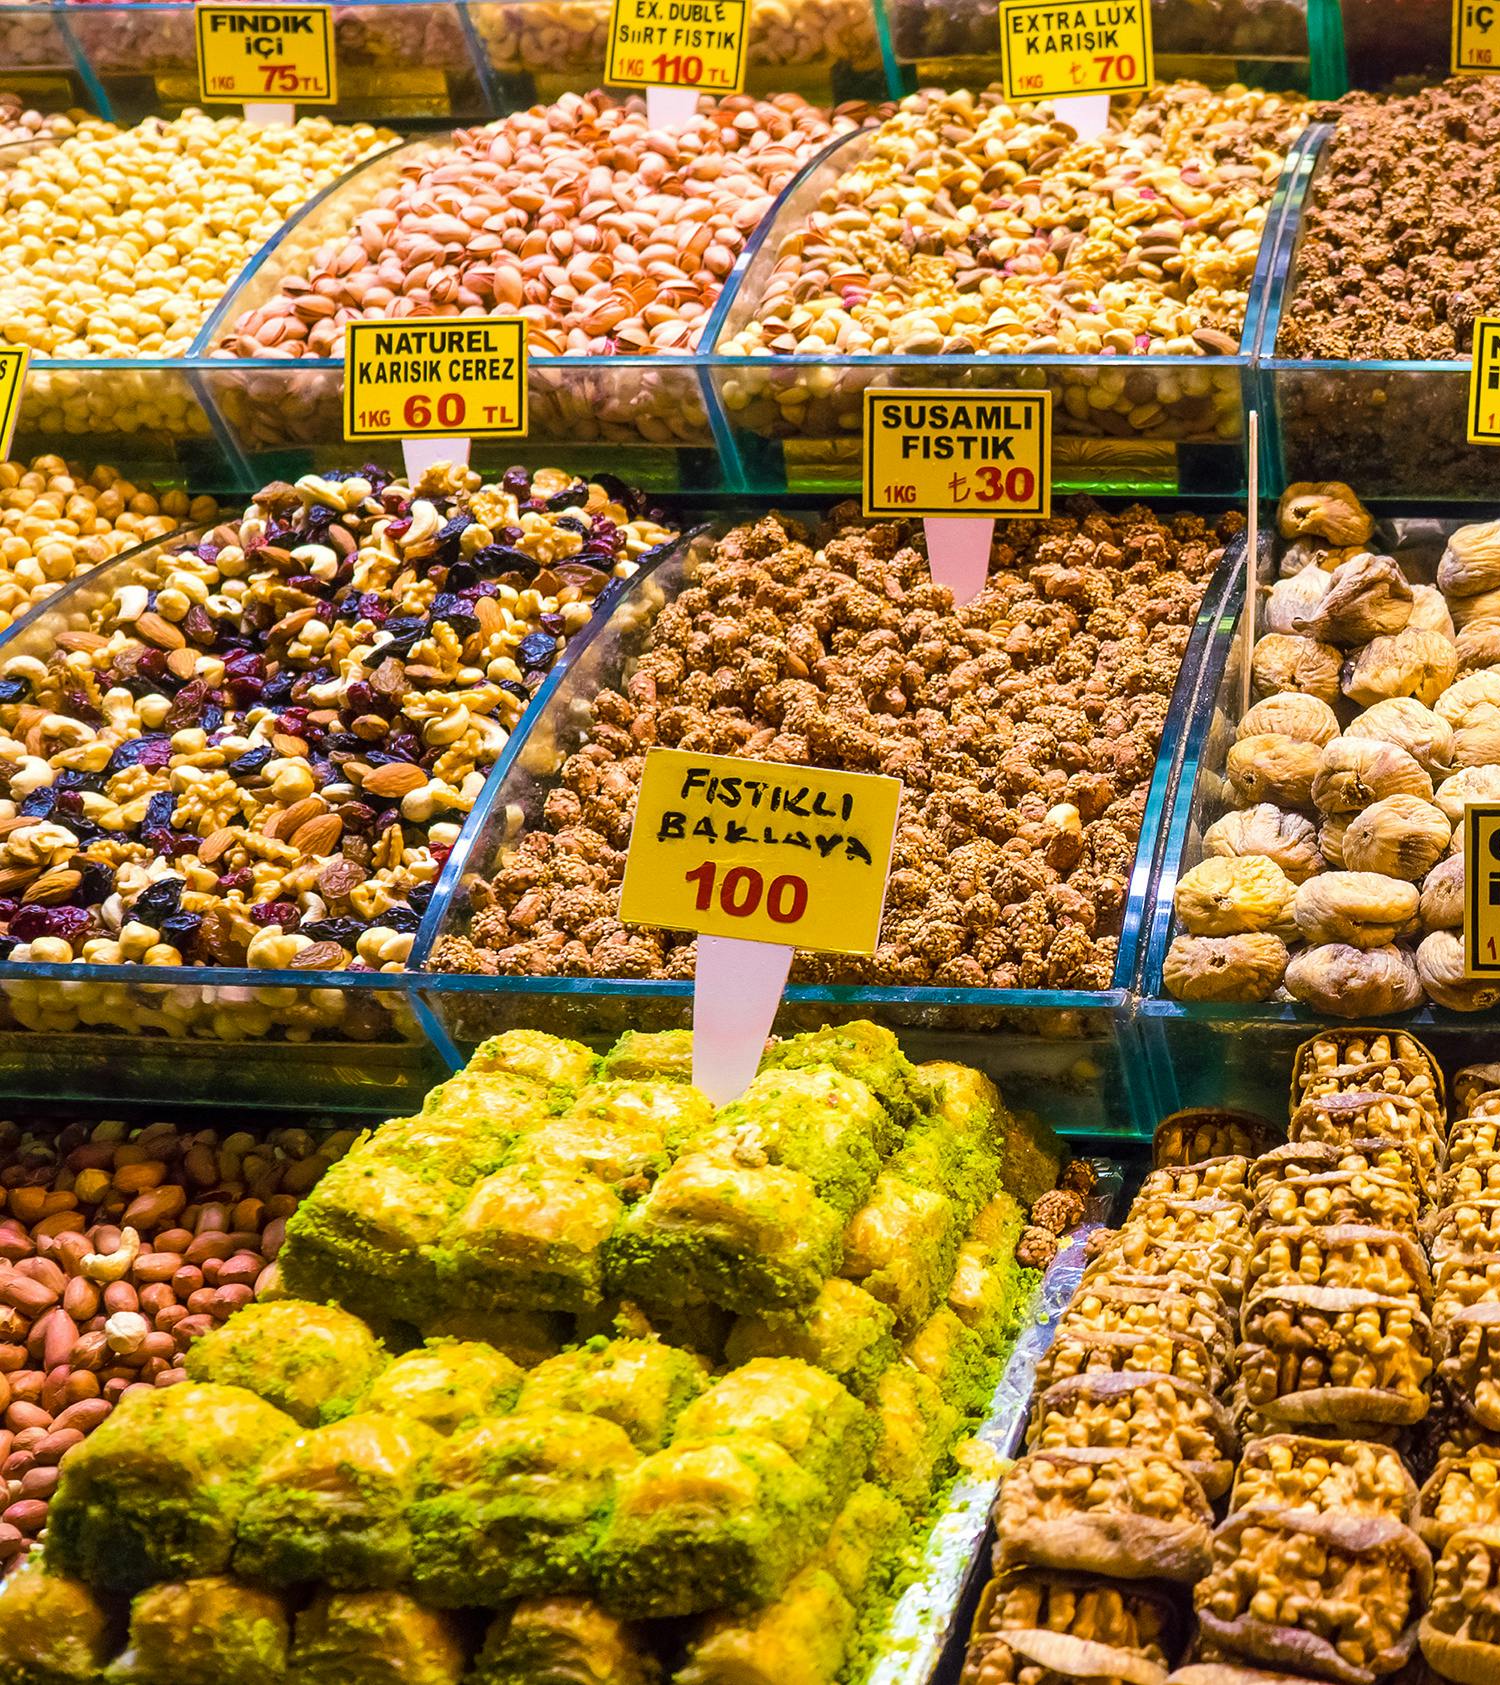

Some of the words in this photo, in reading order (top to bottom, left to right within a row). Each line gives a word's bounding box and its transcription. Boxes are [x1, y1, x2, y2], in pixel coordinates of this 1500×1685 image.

[210, 15, 314, 34] FINDIK
[668, 3, 726, 23] DUBLE
[1012, 10, 1087, 34] EXTRA
[674, 29, 736, 49] FISTIK
[651, 54, 704, 85] 110
[375, 330, 499, 356] NATUREL
[359, 360, 442, 385] KARISIK
[448, 358, 515, 383] CEREZ
[402, 393, 466, 429] 60
[482, 406, 514, 424] TL
[881, 404, 1033, 431] SUSAMLI
[902, 435, 1015, 460] FISTIK
[684, 860, 810, 925] 100
